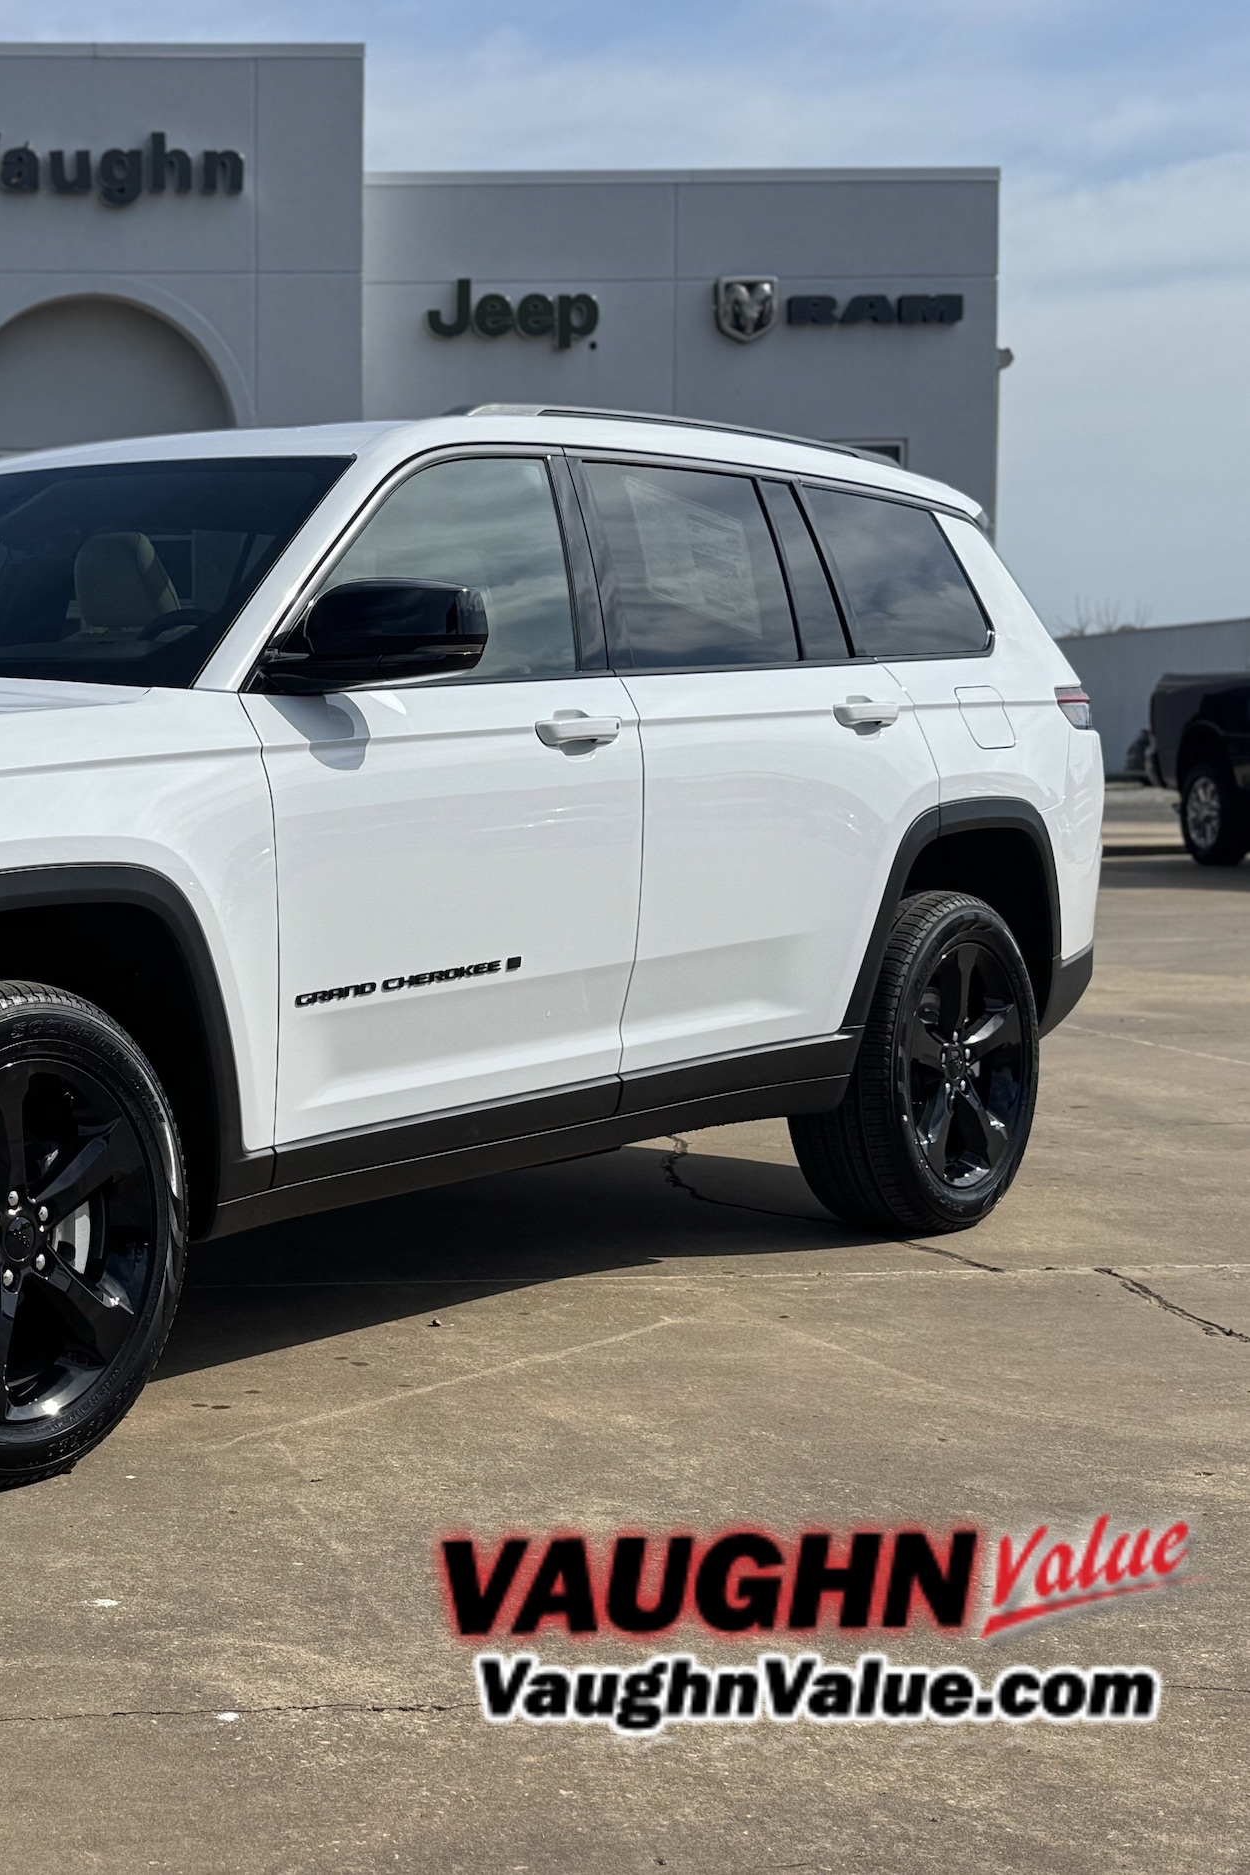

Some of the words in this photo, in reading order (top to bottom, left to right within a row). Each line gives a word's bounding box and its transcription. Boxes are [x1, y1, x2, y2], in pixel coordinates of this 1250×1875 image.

[787, 294, 963, 325] RAM
[295, 981, 376, 1007] GRAND
[382, 959, 501, 992] CHEROKEE
